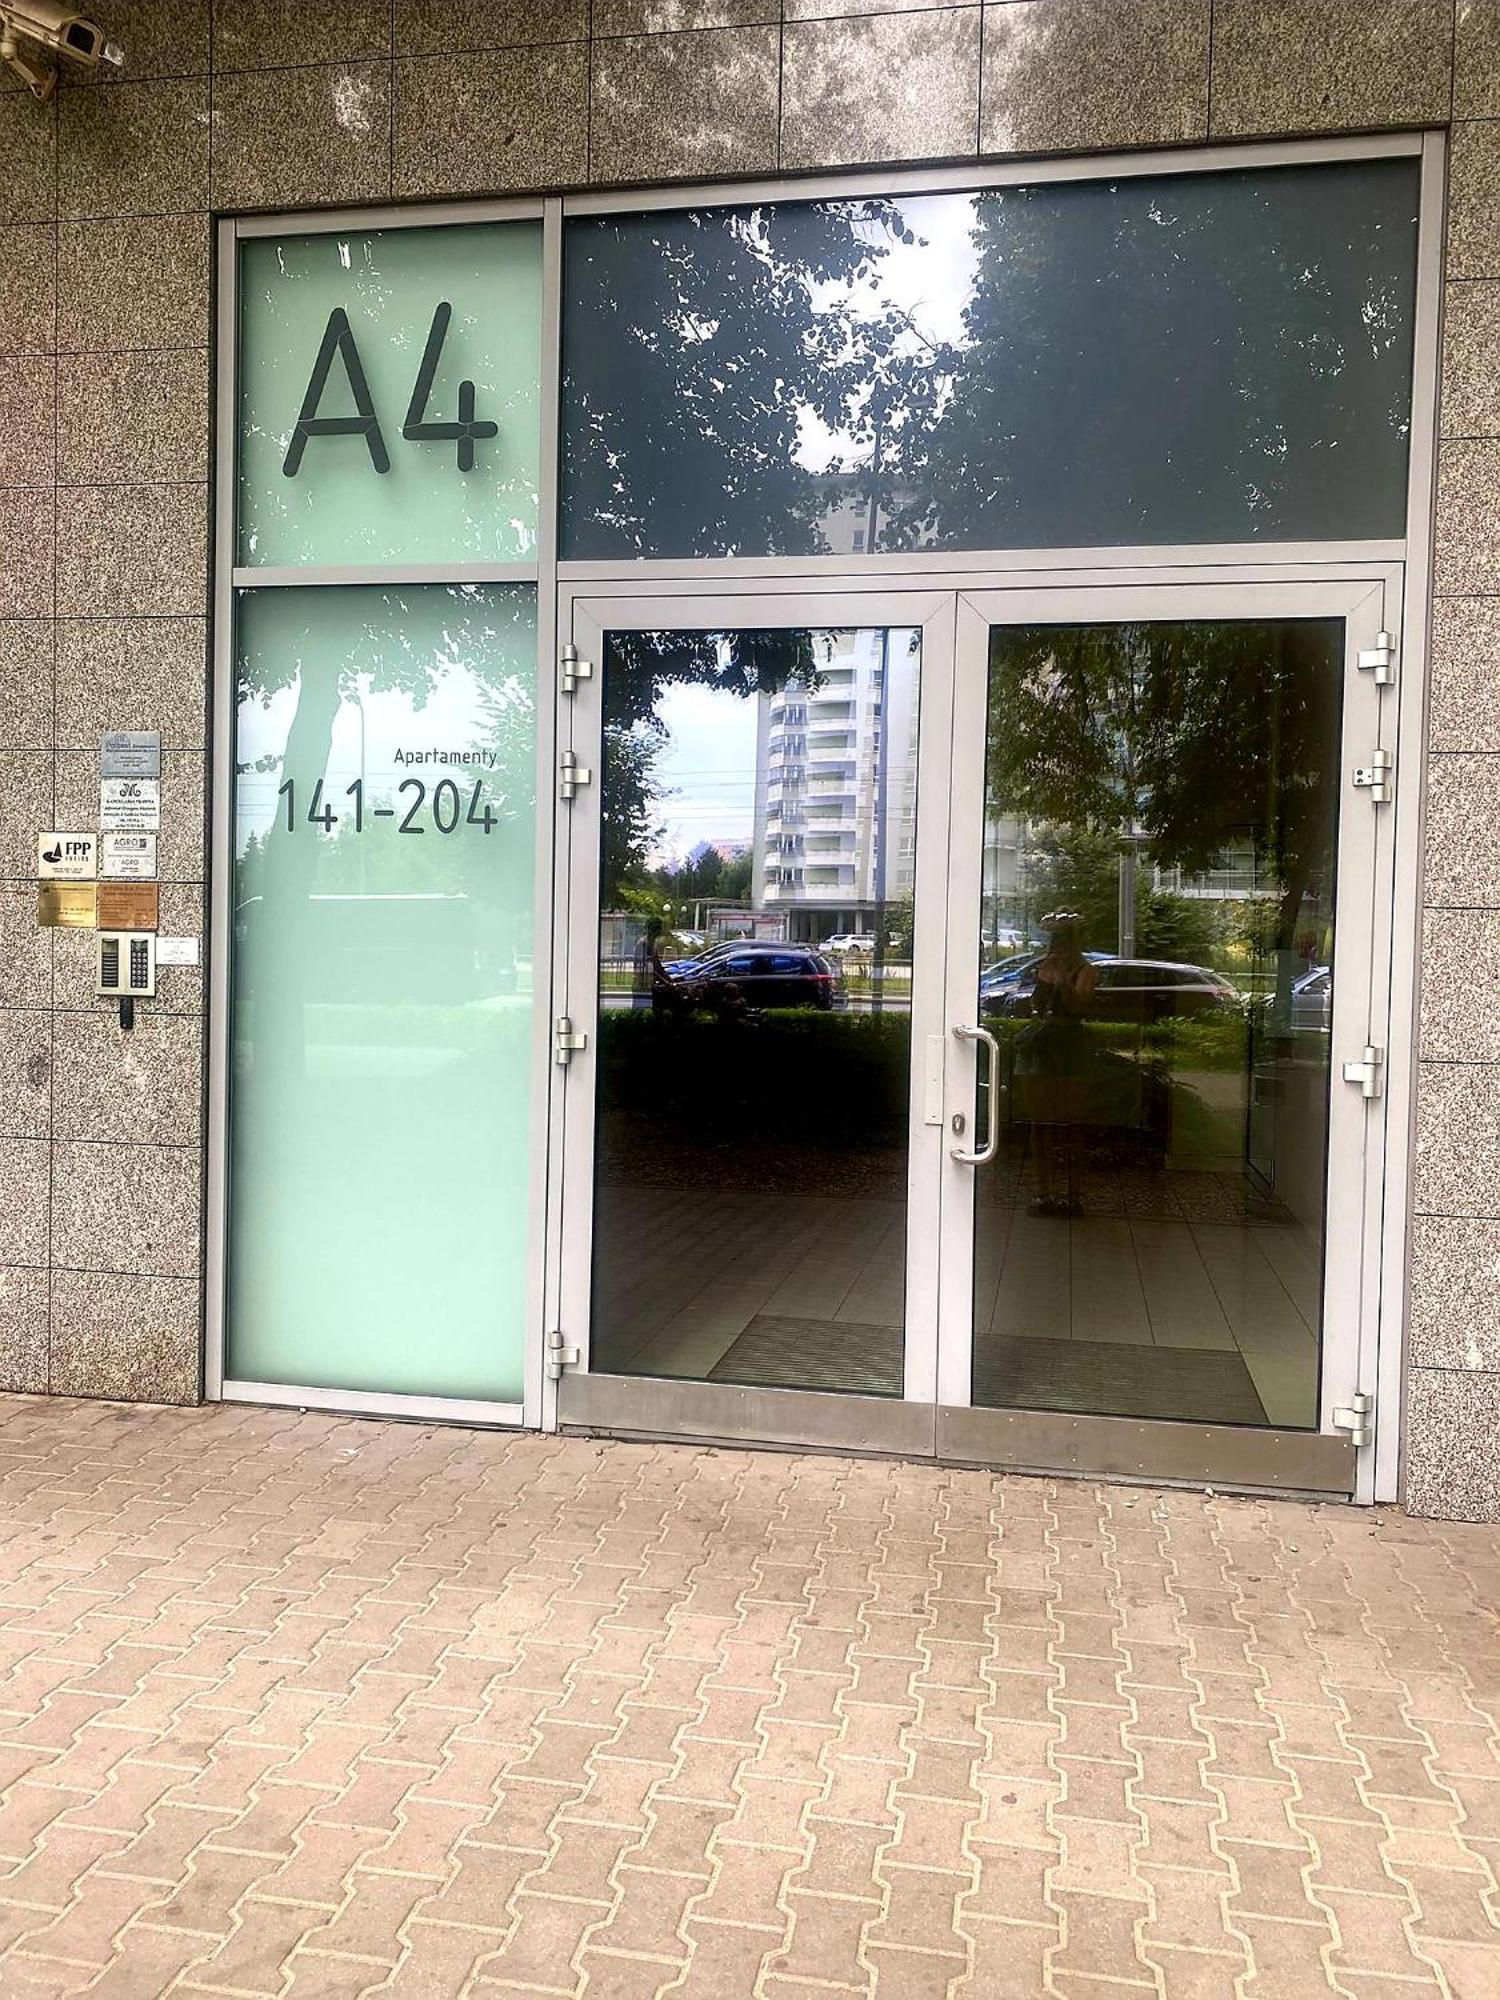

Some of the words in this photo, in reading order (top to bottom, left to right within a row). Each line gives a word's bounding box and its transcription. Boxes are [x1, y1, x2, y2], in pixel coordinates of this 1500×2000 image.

[282, 301, 499, 478] A4
[394, 747, 498, 768] Apartamenty
[278, 778, 499, 835] 141-204
[65, 842, 92, 855] FPP
[114, 837, 138, 846] AGRO
